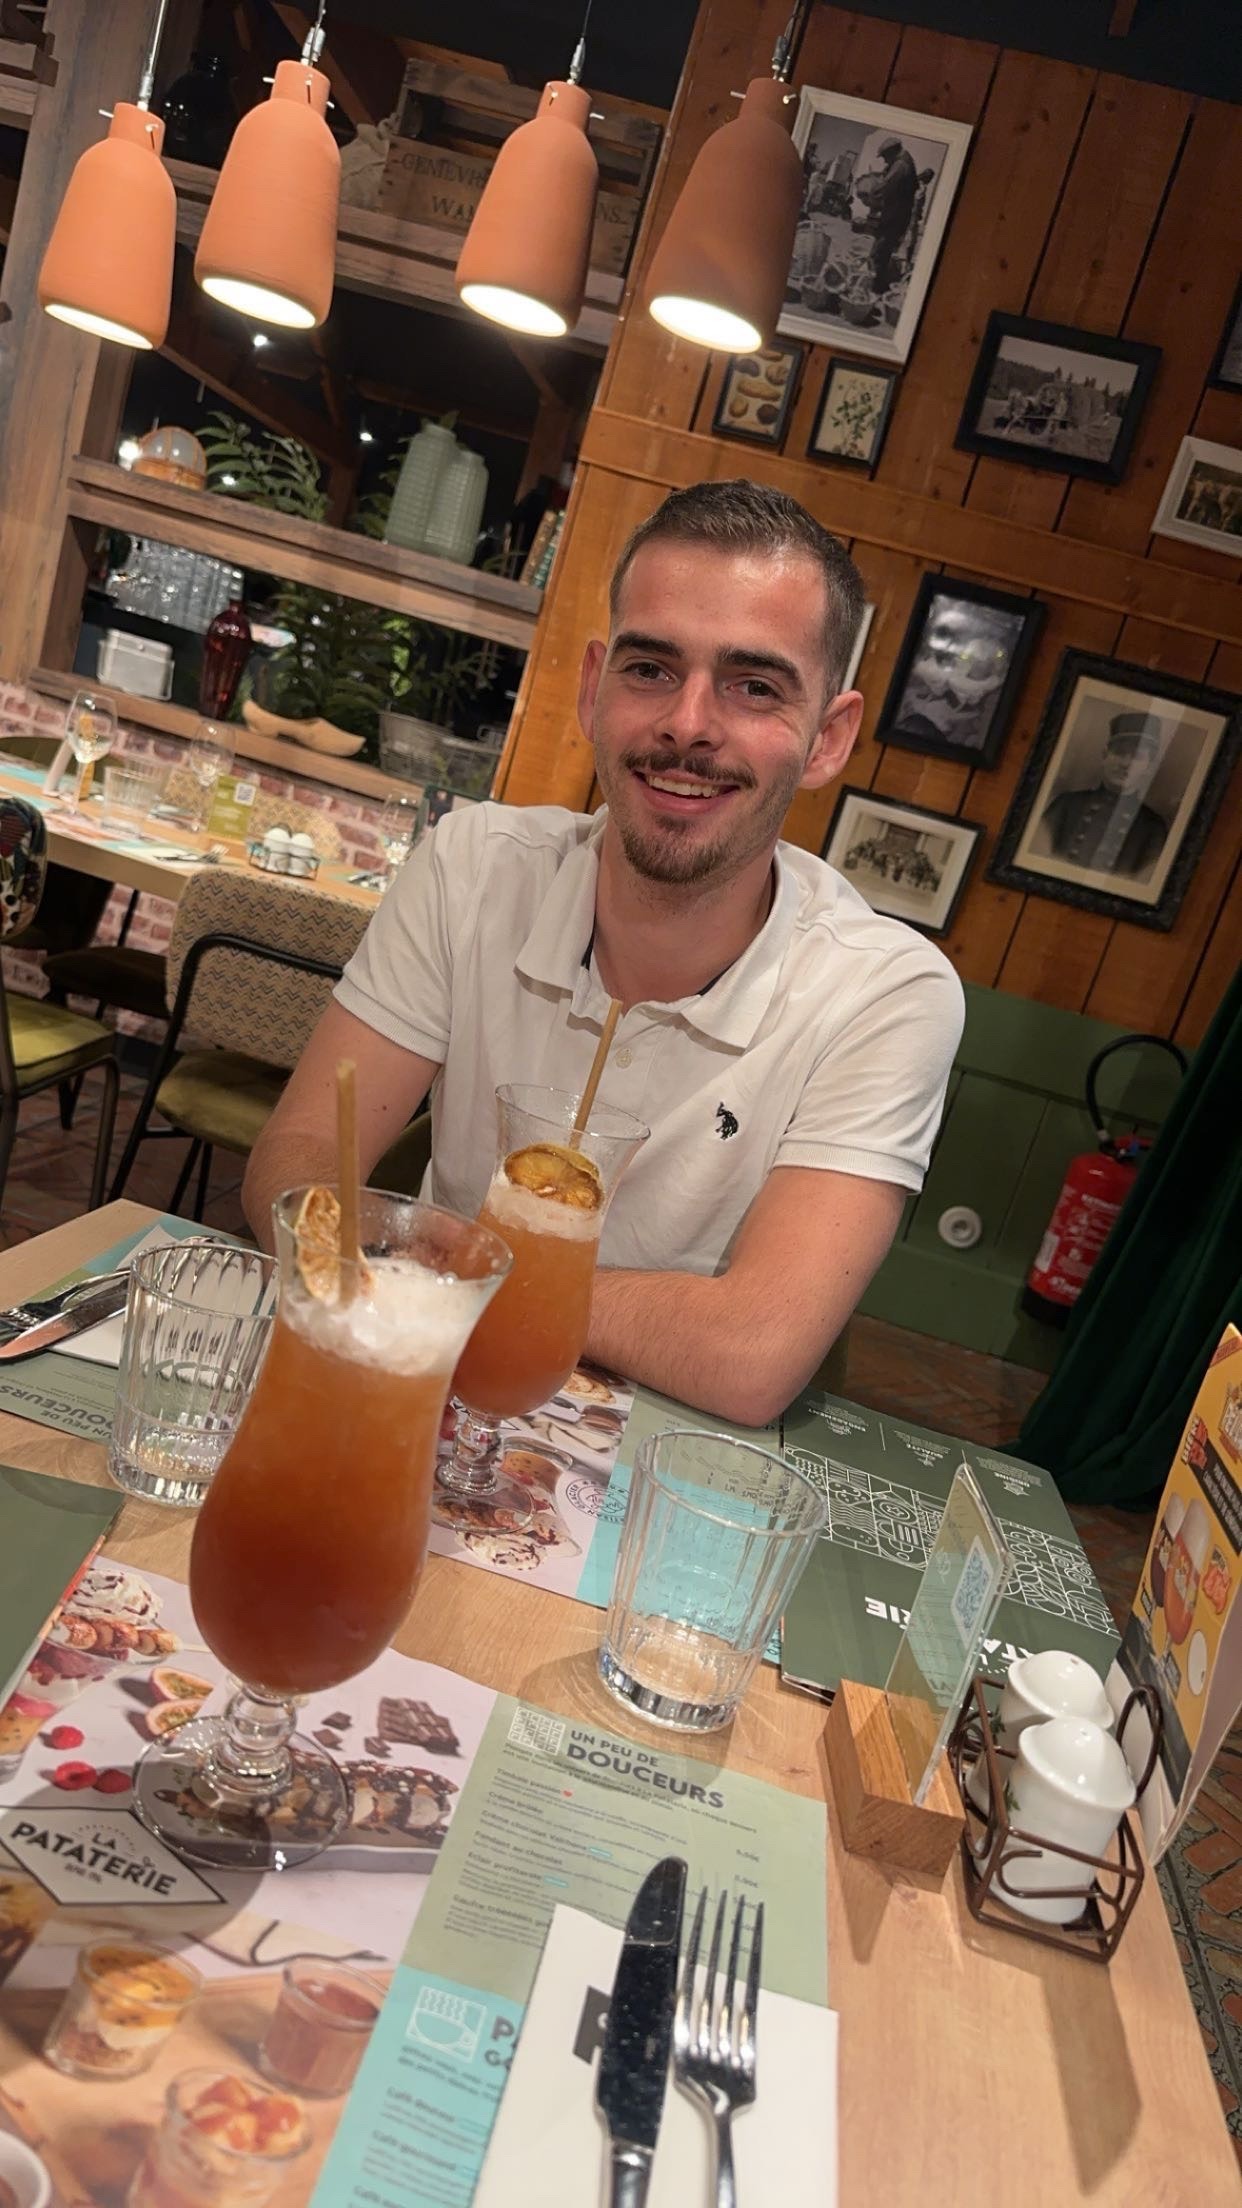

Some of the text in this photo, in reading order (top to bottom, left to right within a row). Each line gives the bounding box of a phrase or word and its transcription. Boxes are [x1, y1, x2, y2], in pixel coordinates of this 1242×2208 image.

[40, 1410, 60, 1420] DE
[62, 1418, 91, 1430] PEU
[570, 1730, 658, 1767] UN PEU DE
[566, 1743, 724, 1809] DOUCEURS
[92, 1833, 116, 1850] LA
[10, 1822, 177, 1896] PATATERIE
